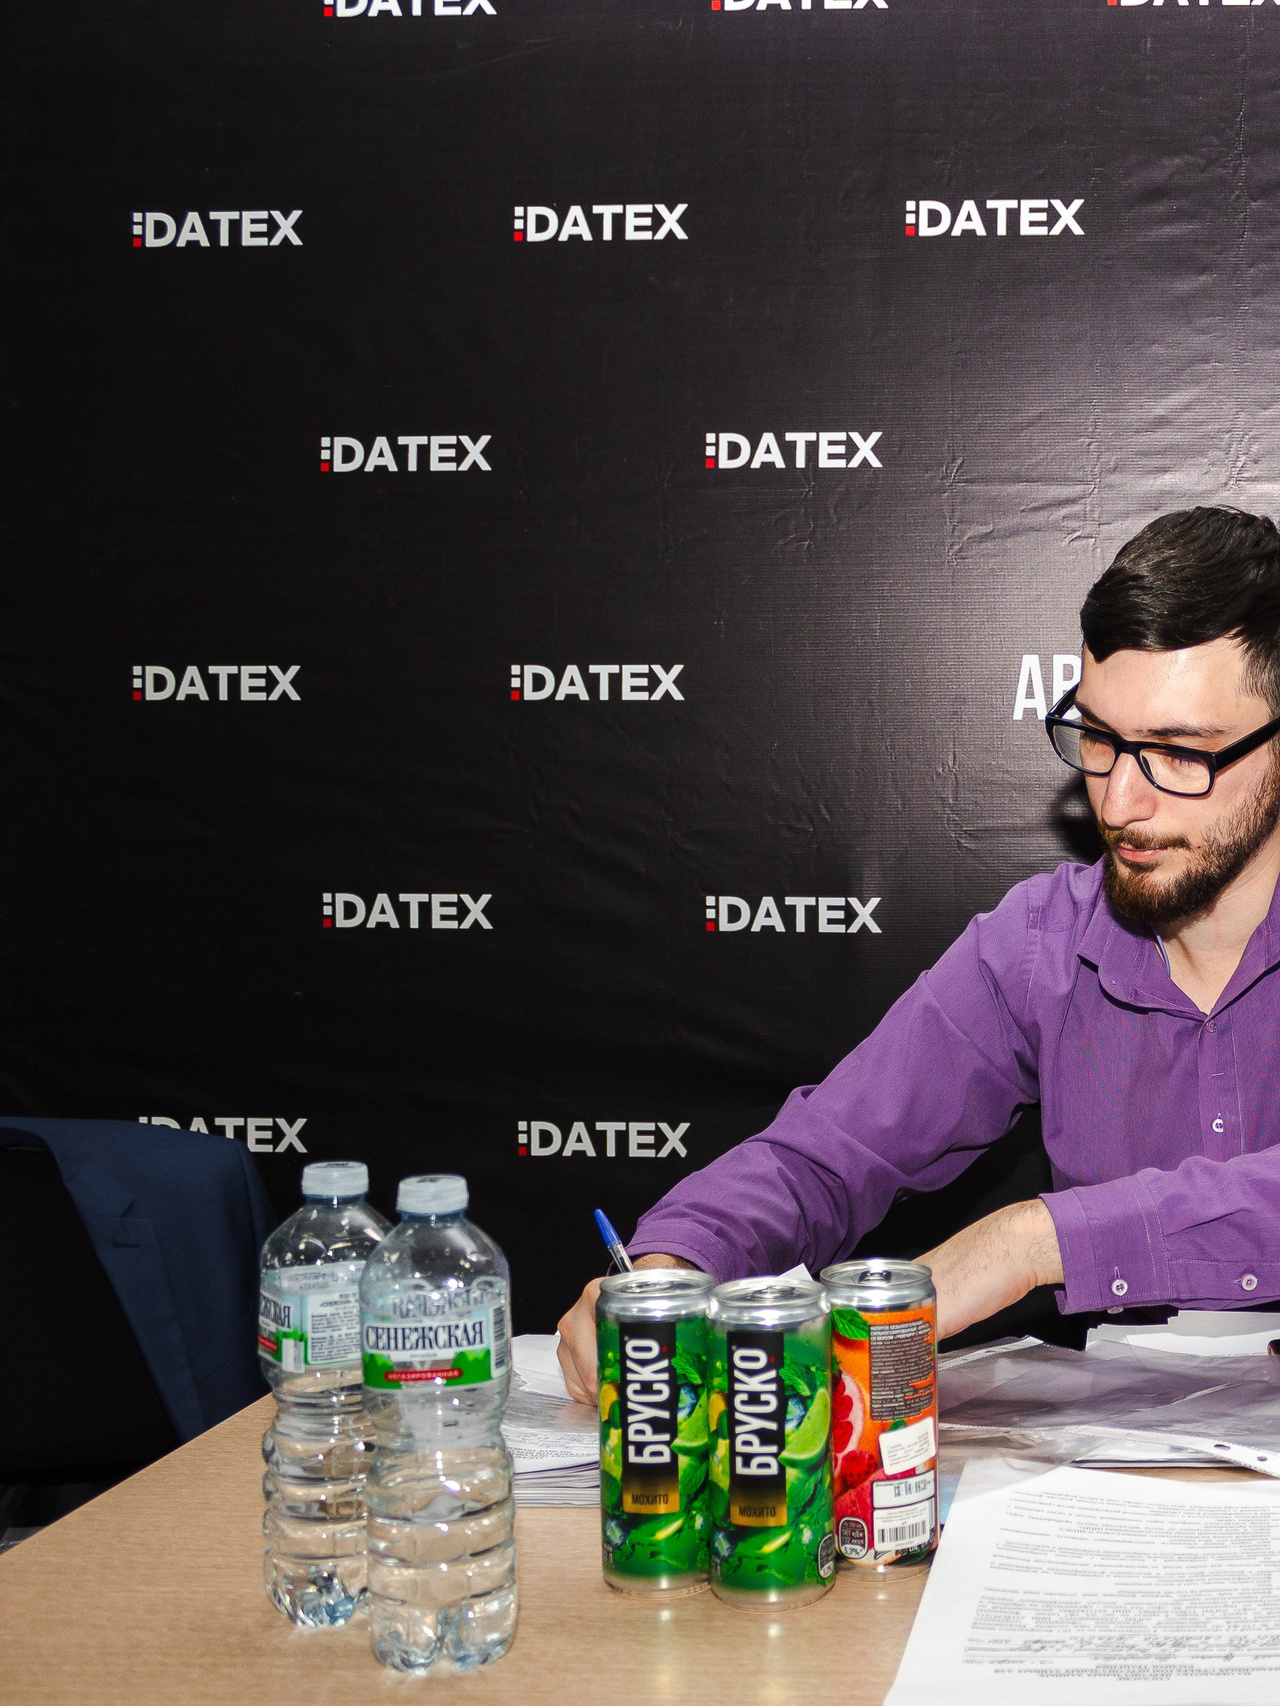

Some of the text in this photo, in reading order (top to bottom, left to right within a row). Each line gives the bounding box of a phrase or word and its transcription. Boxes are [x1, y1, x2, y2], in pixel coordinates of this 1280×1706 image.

[145, 210, 304, 248] DATEX
[526, 203, 689, 243] DATEX
[918, 198, 1086, 237] DATEX
[332, 434, 492, 473] DATEX
[717, 431, 884, 470] DATEX
[145, 665, 302, 701] DATEX
[523, 664, 685, 701] DATEX
[334, 892, 494, 930] DATEX
[718, 895, 883, 934] DATEX
[530, 1120, 691, 1158] DATEX
[366, 1320, 485, 1351] СЕНЕЖСКАЯ
[625, 1337, 672, 1464] БРУСКО
[733, 1347, 780, 1476] БРУСКО
[631, 1492, 669, 1506] МОХИТО
[739, 1505, 776, 1519] МОХИТО
